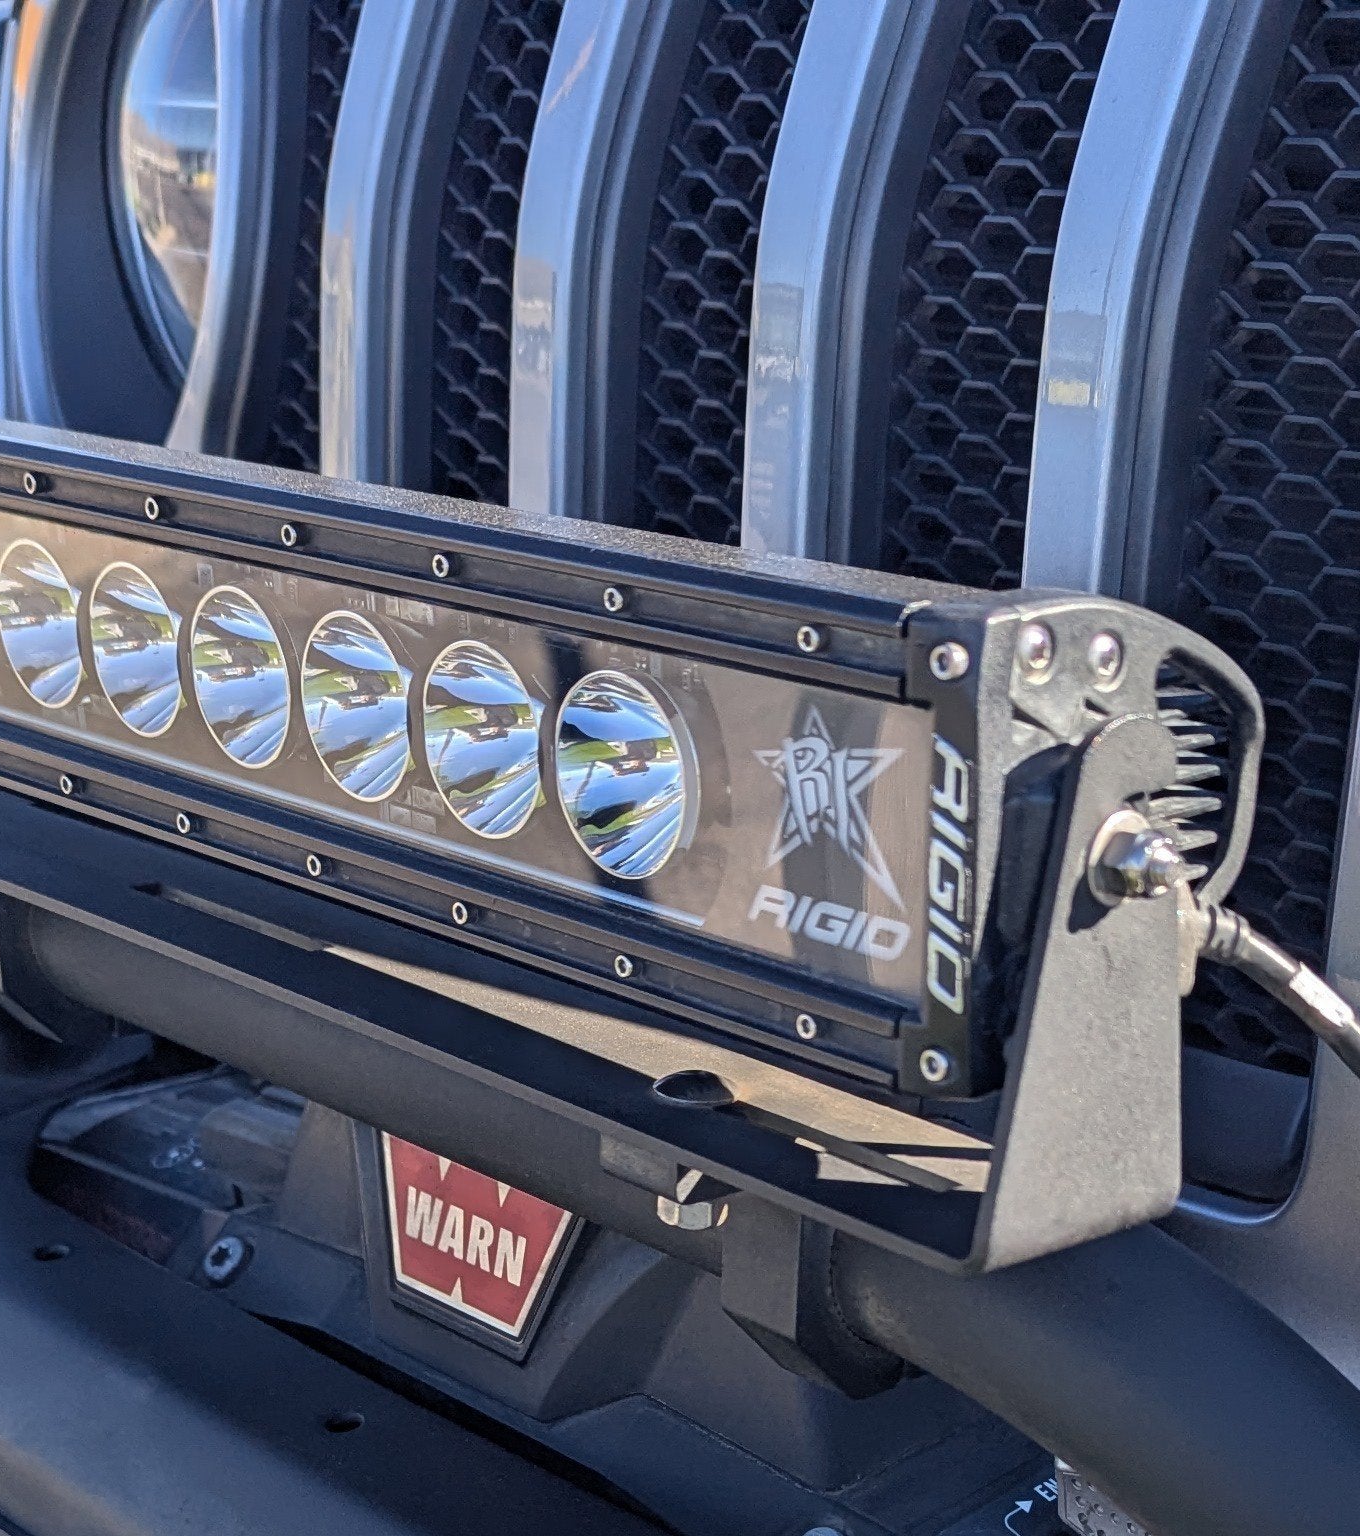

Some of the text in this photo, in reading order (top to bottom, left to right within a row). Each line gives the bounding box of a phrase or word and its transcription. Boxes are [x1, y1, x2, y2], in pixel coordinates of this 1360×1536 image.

[747, 884, 911, 961] RIGID
[926, 732, 972, 1014] RIGID
[405, 1185, 528, 1287] WARN
